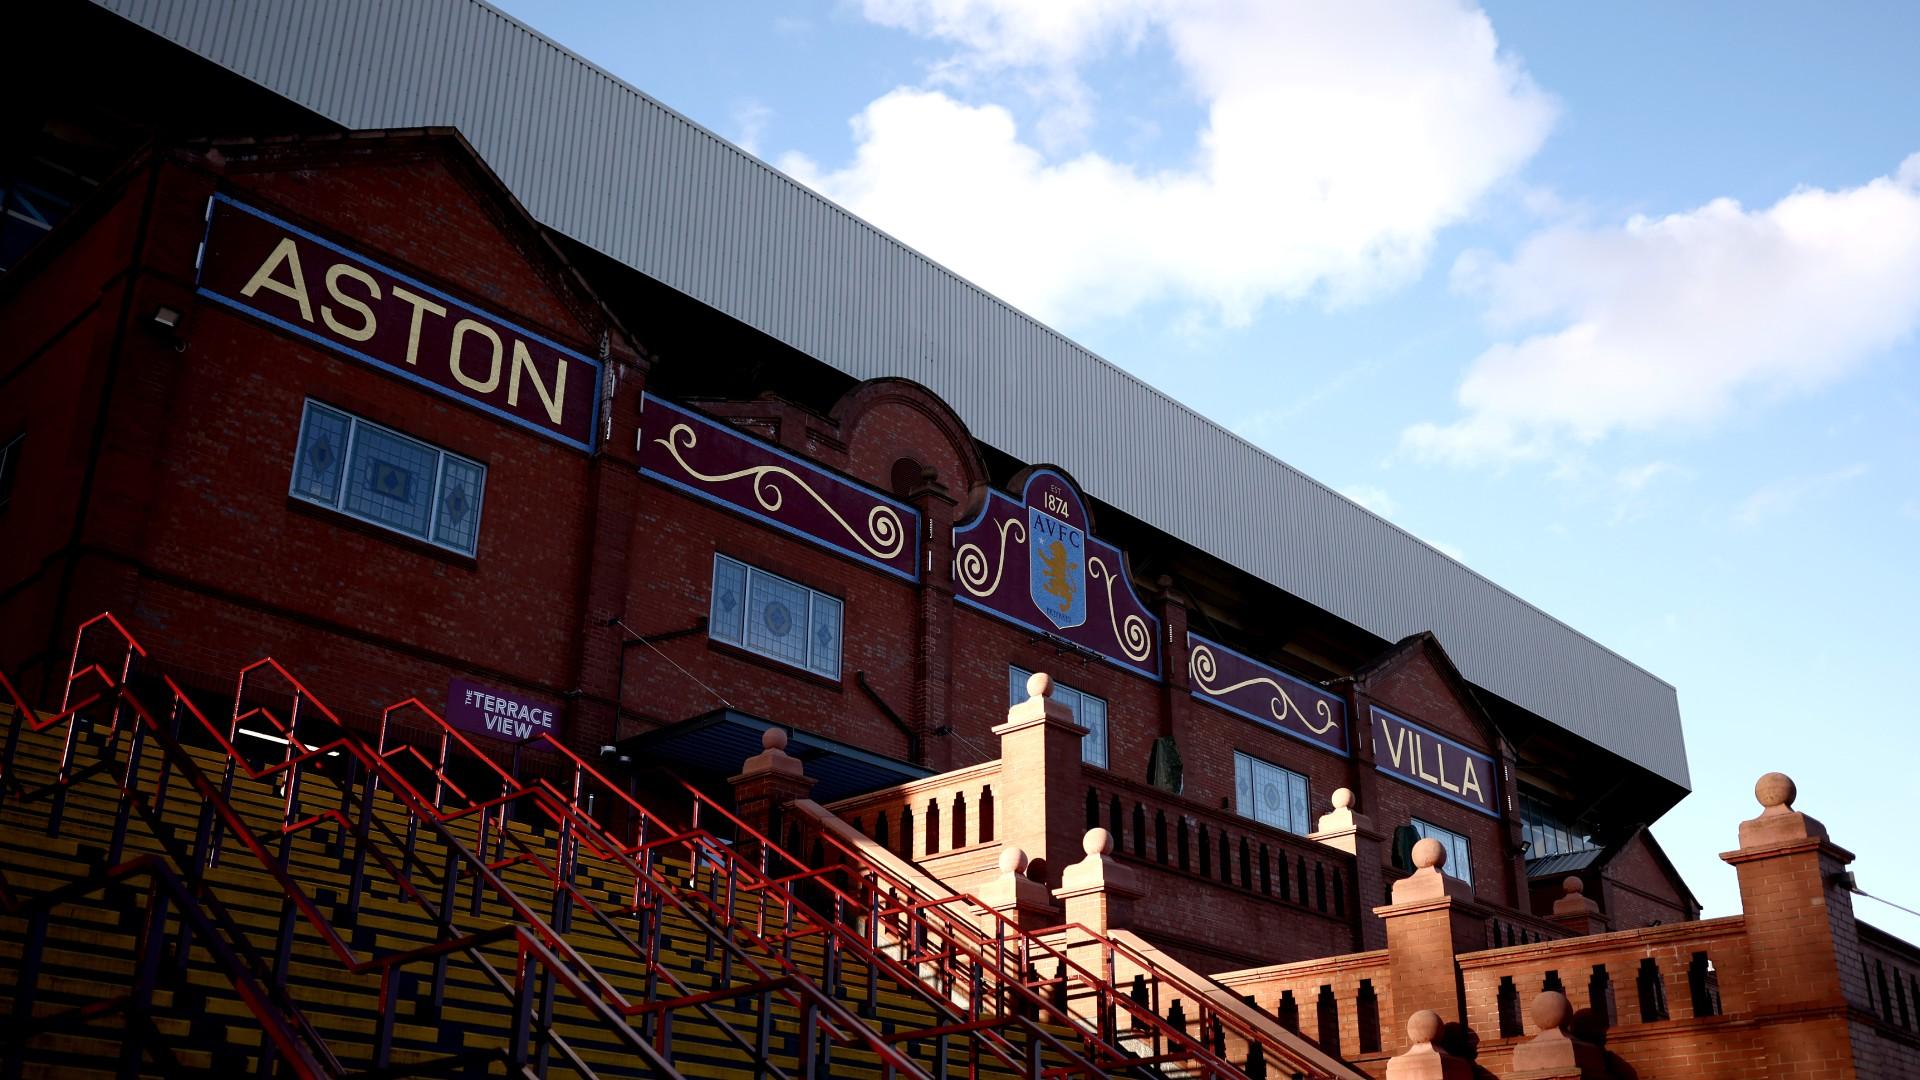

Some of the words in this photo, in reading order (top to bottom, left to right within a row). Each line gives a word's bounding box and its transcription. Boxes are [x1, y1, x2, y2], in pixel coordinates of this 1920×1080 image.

[240, 237, 568, 426] ASTON
[1044, 491, 1069, 518] 1874
[1050, 484, 1062, 495] EST
[1033, 514, 1080, 547] AVFC
[465, 689, 473, 705] THE
[473, 690, 553, 728] TERRACE
[485, 712, 533, 740] VIEW
[1381, 718, 1484, 803] VILLA
